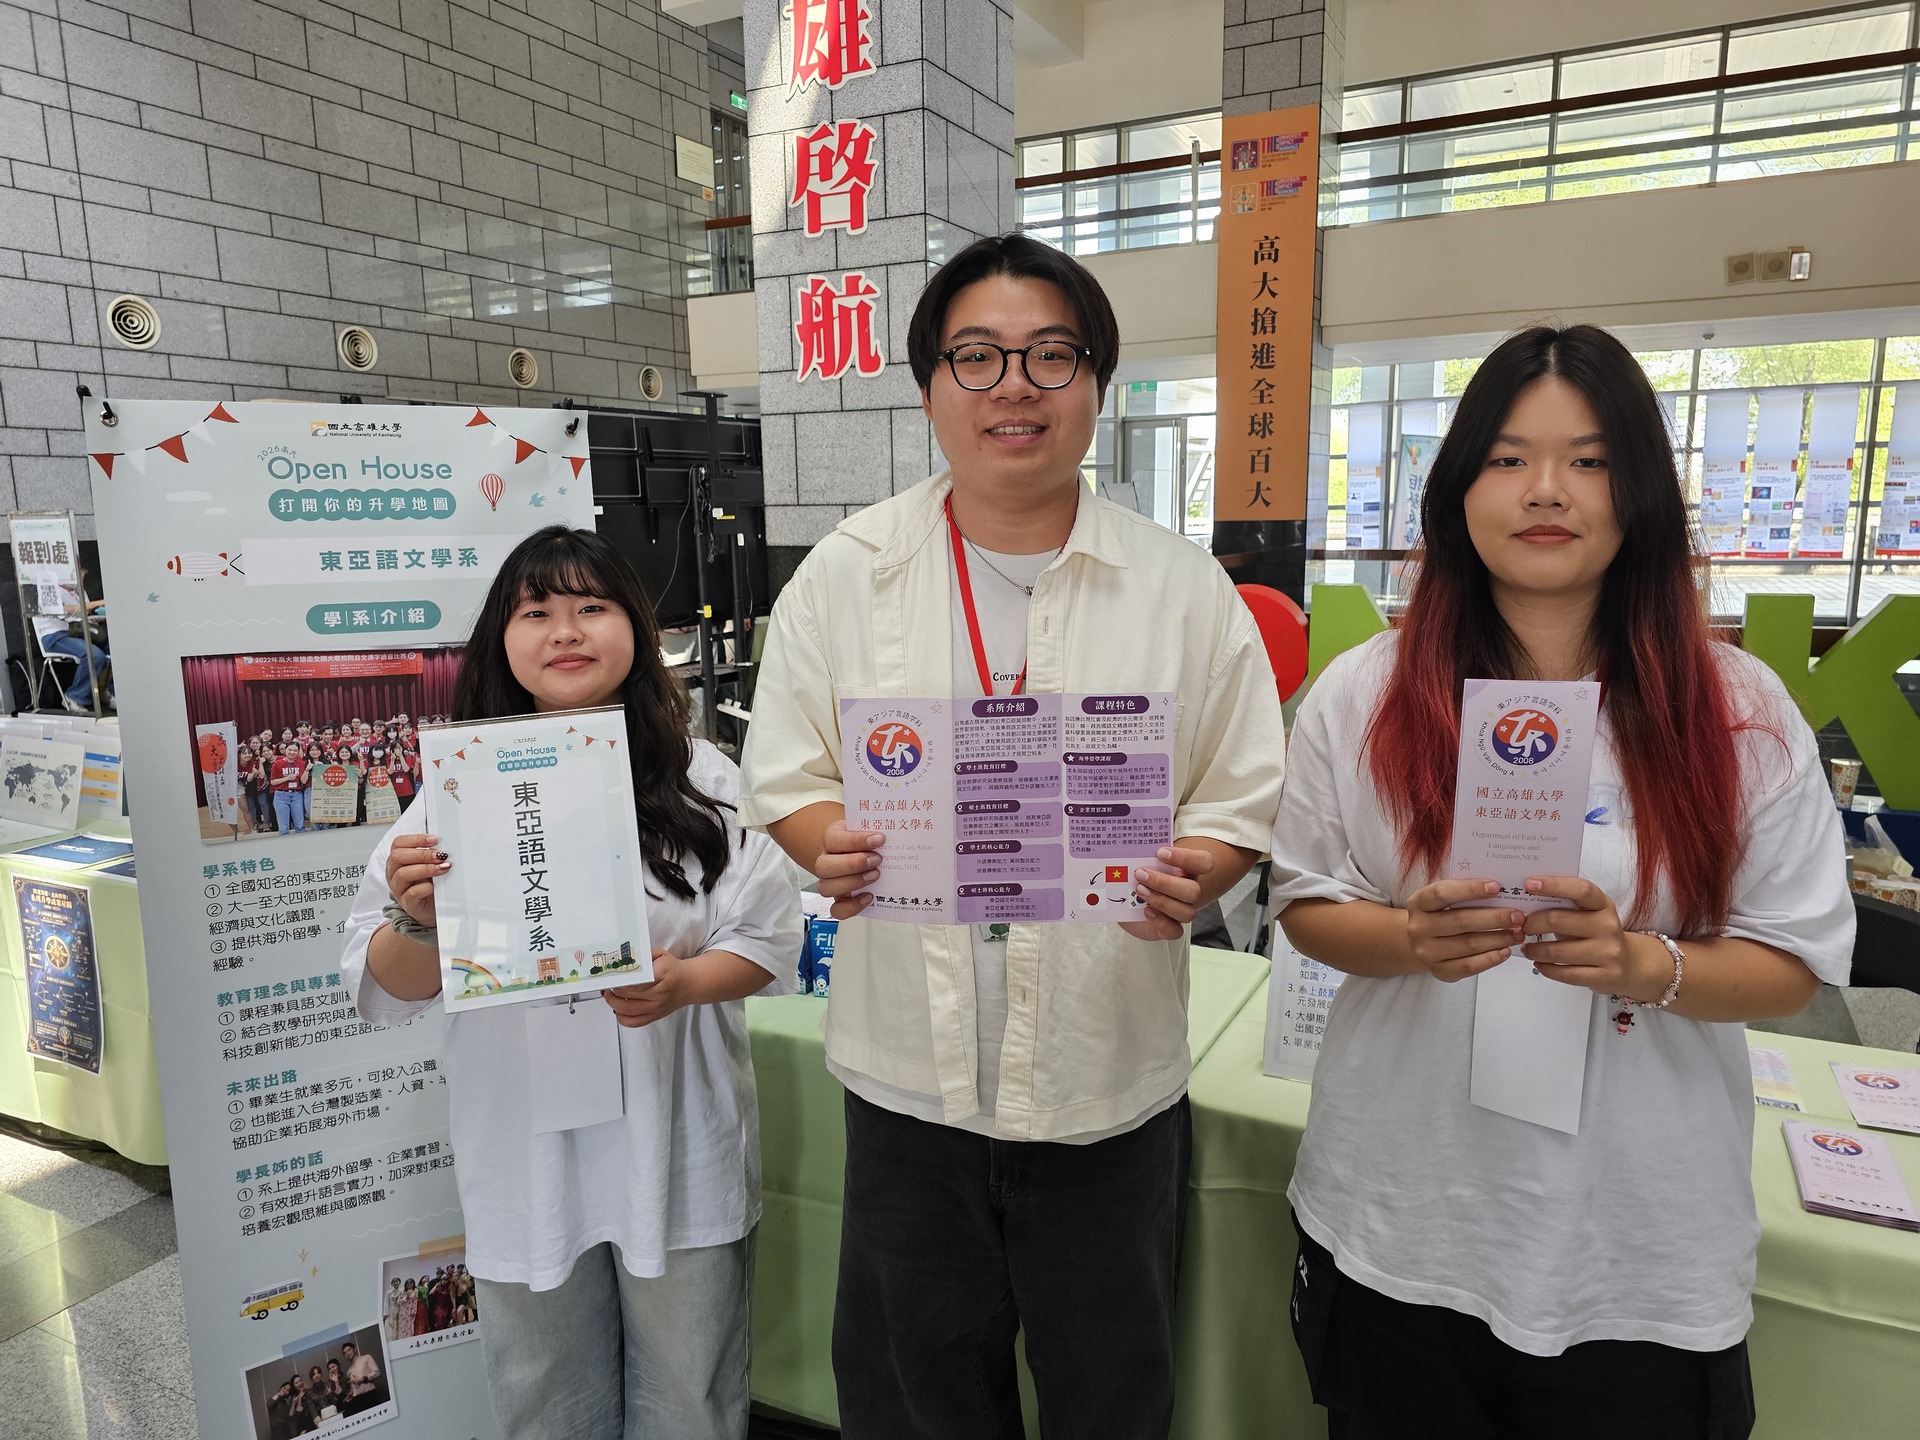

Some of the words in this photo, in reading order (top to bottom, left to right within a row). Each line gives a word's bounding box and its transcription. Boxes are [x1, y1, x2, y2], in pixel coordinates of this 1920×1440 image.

[1260, 136, 1280, 154] THE
[1260, 180, 1278, 198] THE
[1246, 236, 1280, 510] 高大搶進全球百大
[267, 456, 348, 484] Open
[360, 456, 453, 480] House
[278, 497, 449, 513] 打開你的升學地圖
[18, 540, 70, 565] 報到處
[319, 547, 478, 572] 東亞語文學系
[986, 702, 1025, 714] 系所介紹
[1095, 700, 1136, 711] 課程特色
[1496, 695, 1562, 715] 東アジア言語学科
[867, 710, 923, 727] 東アジア言語学科
[1478, 721, 1488, 737] Khoa
[854, 735, 862, 752] Khoa
[496, 750, 522, 760] Open
[526, 746, 557, 756] House
[1512, 756, 1534, 764] 2008
[886, 768, 905, 776] 2008
[1476, 786, 1564, 802] 國立高雄大學
[859, 800, 934, 812] 國立高雄大學
[968, 803, 1009, 811] 碩士班教育目標
[1475, 806, 1561, 821] 東亞語文學系
[860, 818, 934, 831] 東亞語文學系
[1472, 830, 1511, 840] Department
[1537, 834, 1558, 842] Asian
[970, 843, 1010, 851] 學士班核心能力
[1488, 842, 1526, 851] Languages
[1486, 851, 1540, 861] Literature,NUK
[202, 858, 276, 880] 學系特色
[511, 781, 556, 952] 東亞語文學系
[970, 886, 1011, 894] 碩士班核心能力
[209, 908, 326, 936] 經濟與文化議題。
[212, 956, 254, 972] 經驗。
[1300, 970, 1327, 982] 知識？
[216, 972, 342, 1008] 教育理念與專業
[1288, 983, 1296, 993] 3.
[240, 1006, 359, 1040] 結合教學研究與產
[1284, 1010, 1293, 1019] 4.
[1296, 1011, 1326, 1024] 大學期
[1295, 1022, 1324, 1036] 出國交
[1283, 1036, 1291, 1046] 5.
[226, 1069, 298, 1096] 未來出路
[232, 1106, 391, 1151] 協助企業拓展海外市場。
[236, 1150, 324, 1184] 學長姊的話
[242, 1188, 396, 1238] 培養宏觀思維與國際觀。
